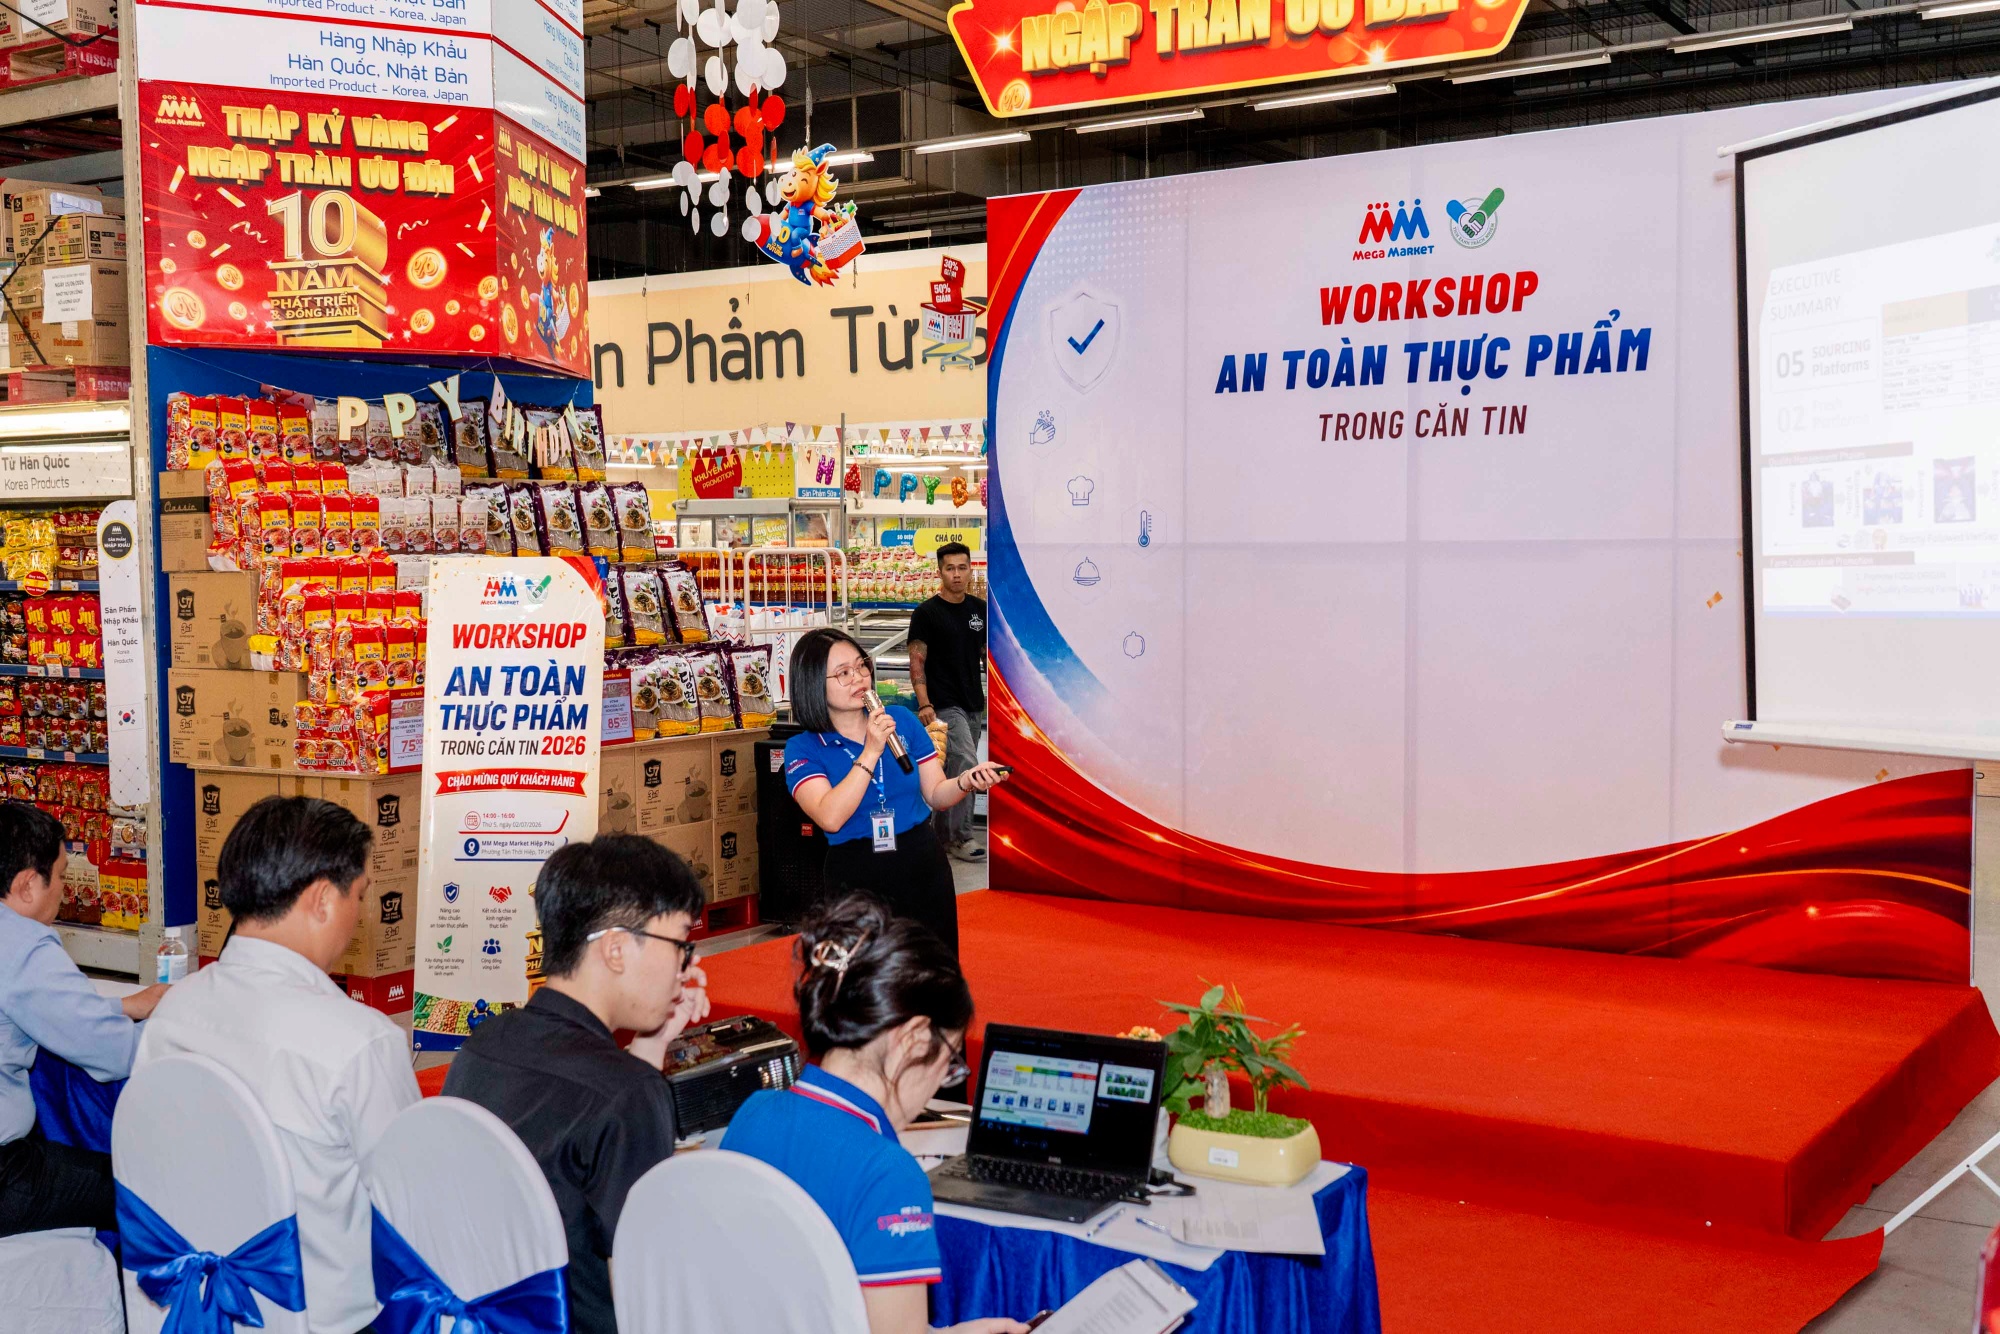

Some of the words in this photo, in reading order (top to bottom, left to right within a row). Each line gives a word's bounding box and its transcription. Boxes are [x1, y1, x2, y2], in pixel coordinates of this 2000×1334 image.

[390, 8, 427, 22] Korea,
[432, 12, 467, 26] Japan
[320, 31, 365, 54] Hàng
[372, 36, 416, 58] Nhập
[423, 40, 467, 60] Khẩu
[1020, 1, 1142, 74] NGẬP
[288, 54, 324, 71] Hàn
[331, 58, 380, 77] Quốc,
[387, 63, 427, 82] Nhật
[435, 67, 468, 84] Bản
[270, 74, 324, 91] Imported
[329, 79, 377, 94] Product
[392, 85, 429, 99] Korea,
[434, 90, 469, 102] Japan
[221, 104, 299, 146] THẬP
[308, 107, 346, 148] KỶ
[351, 113, 428, 152] VÀNG
[187, 144, 272, 186] NGẬP
[275, 151, 352, 188] TRÀN
[359, 154, 399, 190] ƯU
[403, 158, 454, 197] ĐÃI
[268, 190, 358, 260] 10
[1352, 249, 1385, 261] Mega
[1388, 245, 1434, 258] Market
[944, 259, 958, 271] 30%
[276, 262, 354, 292] NĂM
[1770, 268, 1841, 295] EXECUTIVE
[934, 283, 950, 294] 50%
[936, 293, 951, 303] GIẢM
[1320, 270, 1539, 326] WORKSHOP
[270, 296, 312, 309] PHÁT
[314, 291, 358, 306] TRIỂN
[1770, 296, 1841, 321] SUMMARY
[272, 310, 281, 320] &
[286, 308, 322, 319] ĐỒNG
[326, 304, 360, 317] HÀNH
[647, 297, 805, 386] Phẩm
[830, 304, 919, 374] Từ
[1812, 338, 1871, 358] SOURCING
[1214, 353, 1268, 394] AN
[1282, 337, 1388, 390] TOÀN
[1404, 333, 1512, 396] THỰC
[1525, 308, 1652, 377] PHẨM
[1776, 350, 1805, 378] 05
[1812, 359, 1869, 377] Platforms
[1319, 410, 1404, 442] TRONG
[1415, 403, 1469, 439] CĂN
[1482, 404, 1527, 436] TIN
[2, 457, 16, 472] Từ
[20, 456, 40, 470] Hàn
[43, 452, 70, 469] Quốc
[4, 478, 28, 491] Korea
[31, 476, 69, 489] Products
[702, 470, 735, 489] PROMOTION
[813, 488, 826, 497] Phẩm
[935, 533, 948, 542] CHẢ
[119, 605, 137, 613] Phẩm
[179, 596, 192, 608] G7
[122, 616, 138, 624] Khẩu
[121, 638, 138, 646] Quốc
[452, 622, 587, 649] WORKSHOP
[444, 665, 492, 697] AN
[500, 659, 586, 697] TOÀN
[178, 693, 193, 704] G7
[439, 700, 507, 736] THỰC
[514, 696, 589, 730] PHẨM
[608, 718, 620, 728] 85
[402, 739, 416, 752] 75
[440, 740, 485, 755] TRONG
[489, 736, 518, 755] CĂN
[519, 740, 539, 755] TIN
[541, 735, 586, 755] 2026
[447, 773, 471, 787] CHÀO
[473, 772, 498, 786] MỪNG
[500, 772, 518, 786] QUÝ
[519, 771, 550, 786] KHÁCH
[551, 774, 575, 788] HÀNG
